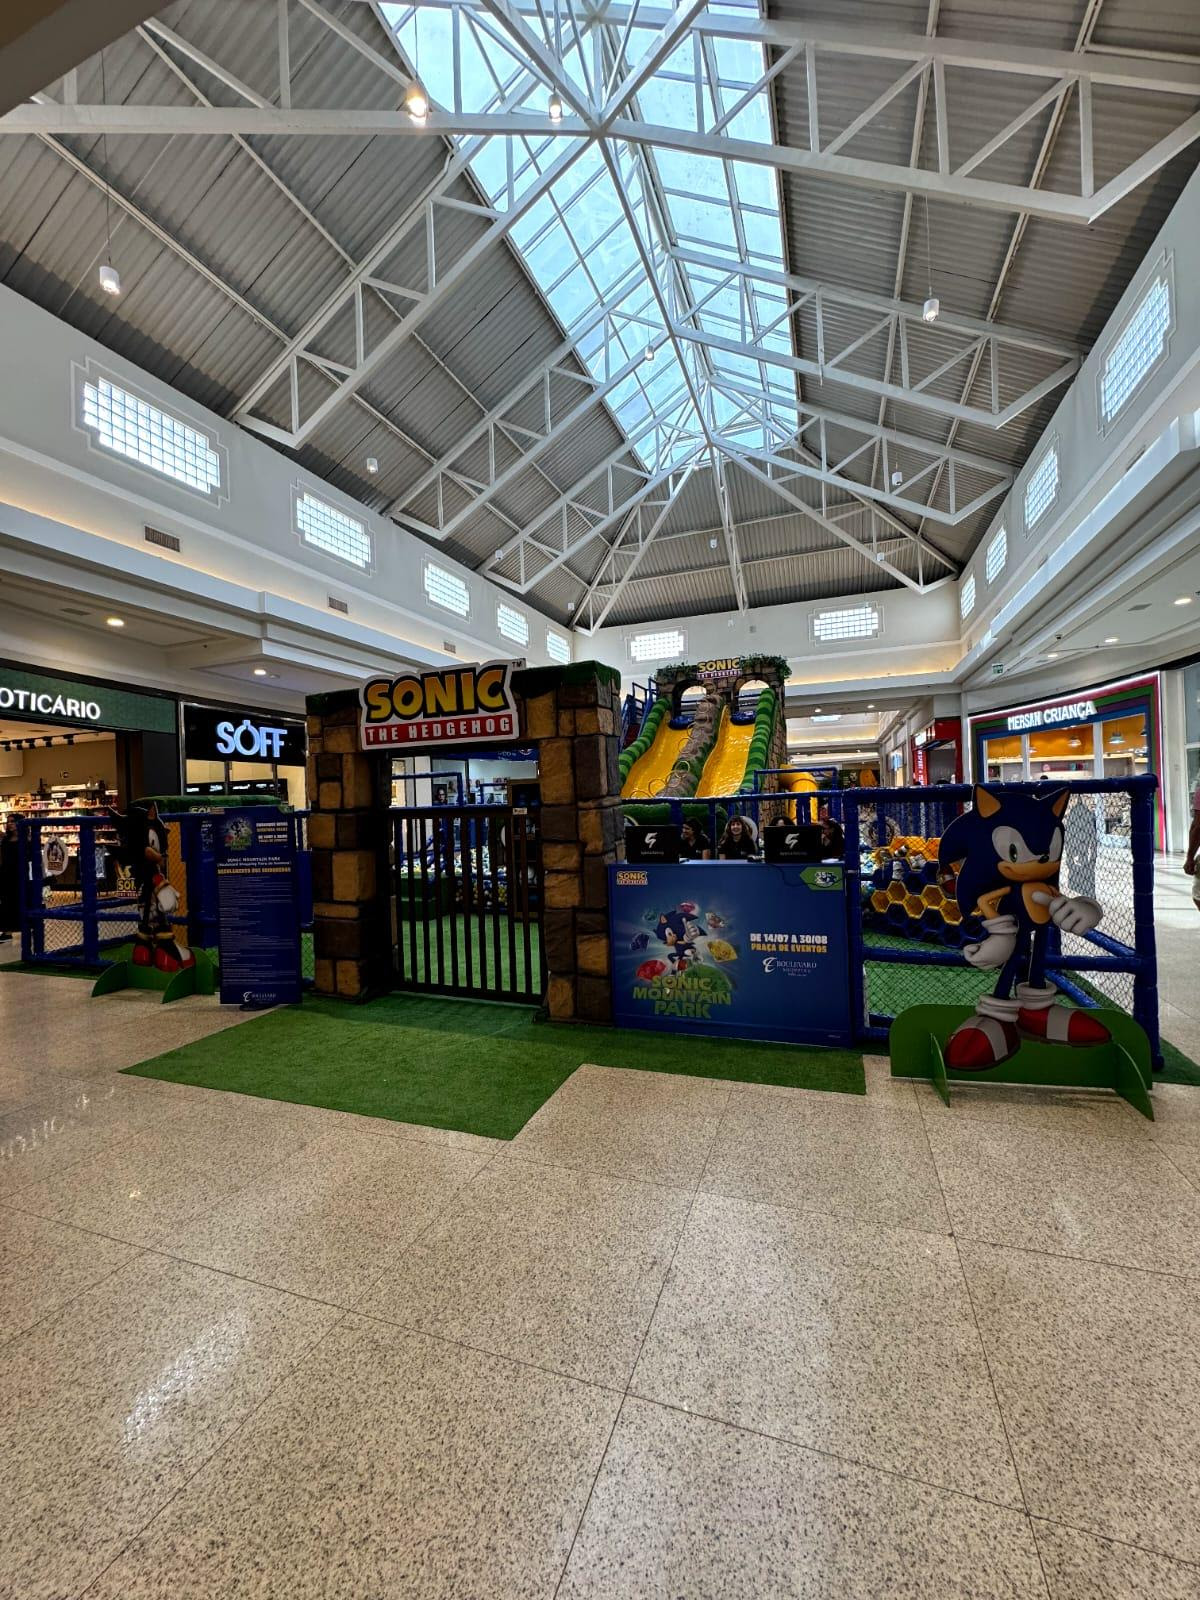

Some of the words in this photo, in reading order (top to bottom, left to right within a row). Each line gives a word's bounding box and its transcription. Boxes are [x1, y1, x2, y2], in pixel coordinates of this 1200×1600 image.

[698, 659, 740, 672] SONIC
[365, 667, 508, 721] SONIC
[1043, 701, 1097, 721] CRIANÇA
[368, 727, 399, 741] THE
[408, 717, 510, 739] HEDGEHOG
[618, 872, 646, 880] SONIC
[750, 933, 761, 942] DE
[763, 933, 788, 943] 14/07
[791, 934, 797, 943] A
[800, 935, 828, 944] 30/08
[751, 943, 777, 952] PRAÇA
[779, 944, 788, 952] DE
[791, 944, 827, 953] EVENTOS
[777, 961, 817, 969] BOULEVARD
[651, 975, 712, 990] SONIC
[633, 987, 732, 1005] MOUNTAIN
[654, 1000, 711, 1019] PARK
